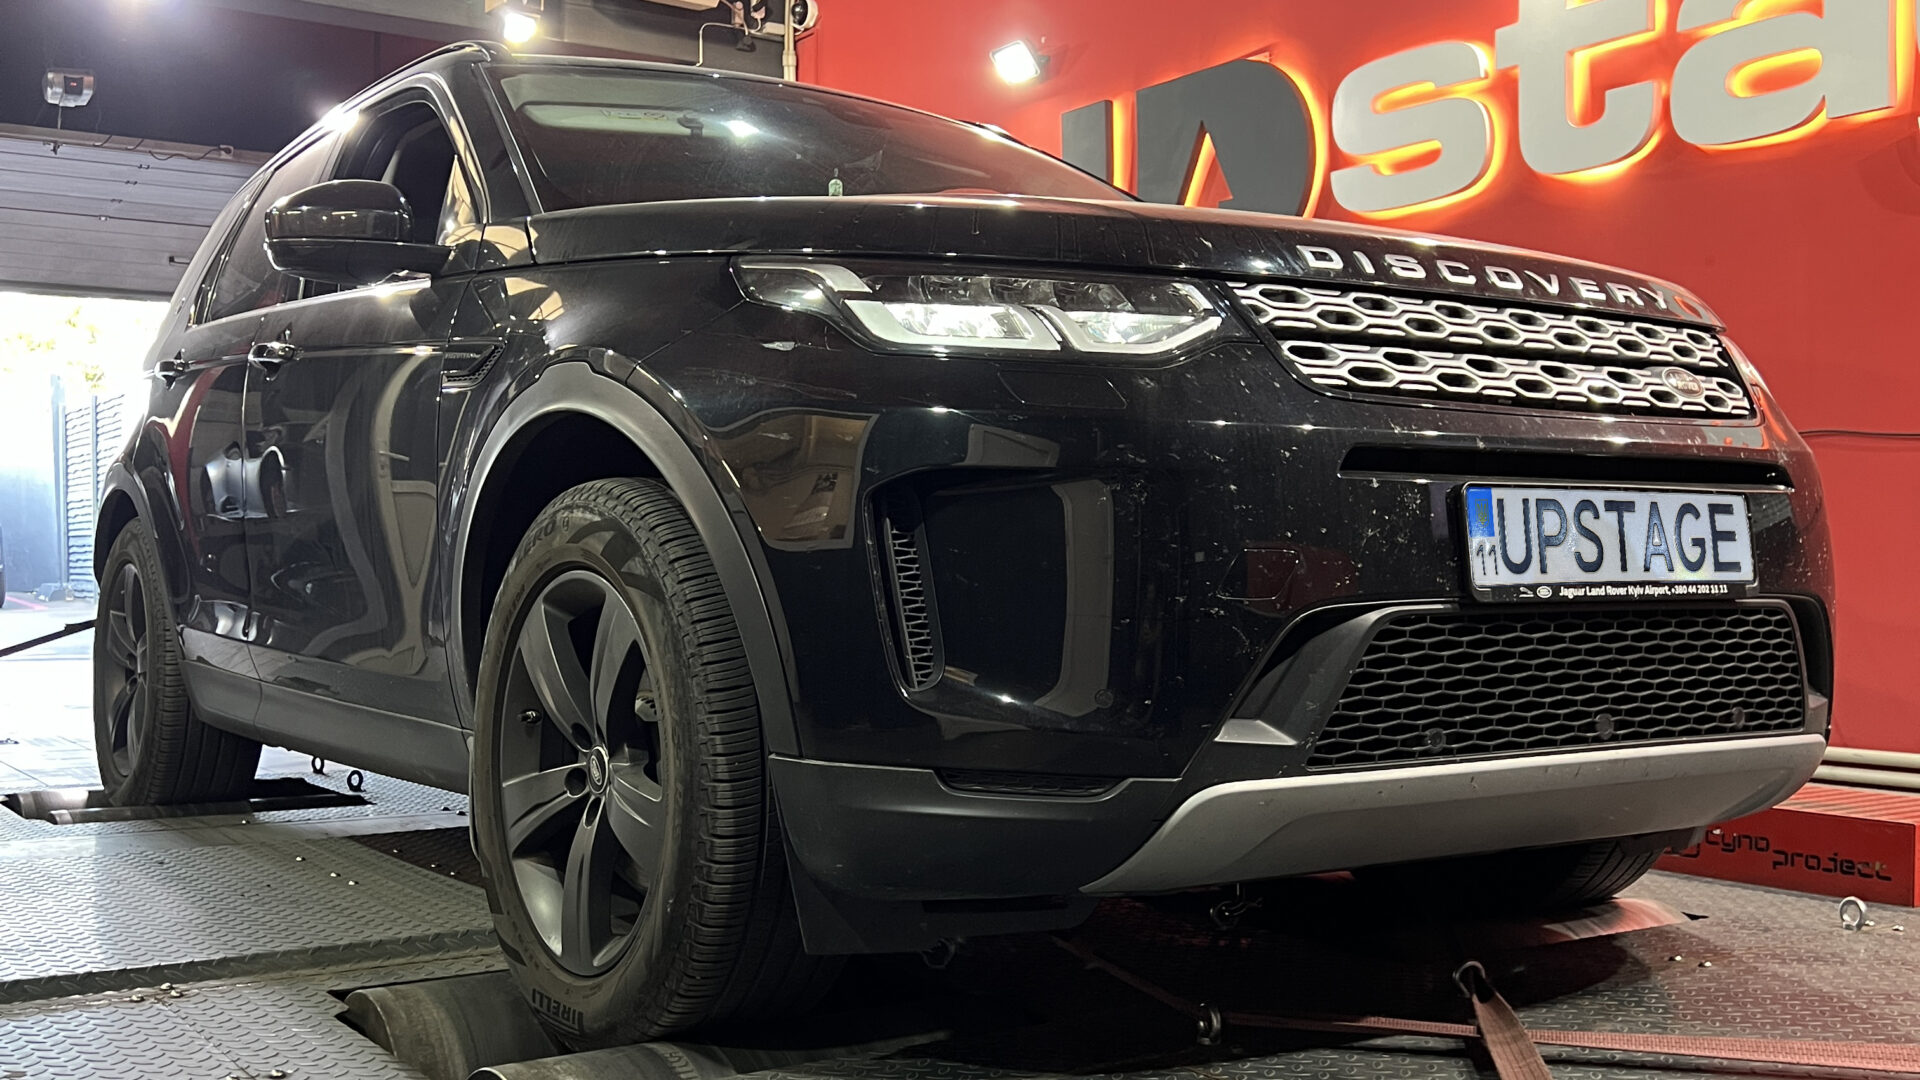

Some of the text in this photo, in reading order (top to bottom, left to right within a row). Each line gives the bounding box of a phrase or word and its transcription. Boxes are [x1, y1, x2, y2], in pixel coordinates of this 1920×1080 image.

[1296, 245, 1669, 310] DISCOVERY
[1497, 498, 1742, 575] UPSTAGE
[1559, 585, 1728, 599] Jaguar Land Rover Kyiv Airport, +380 44 202 11 11
[1772, 850, 1892, 882] project
